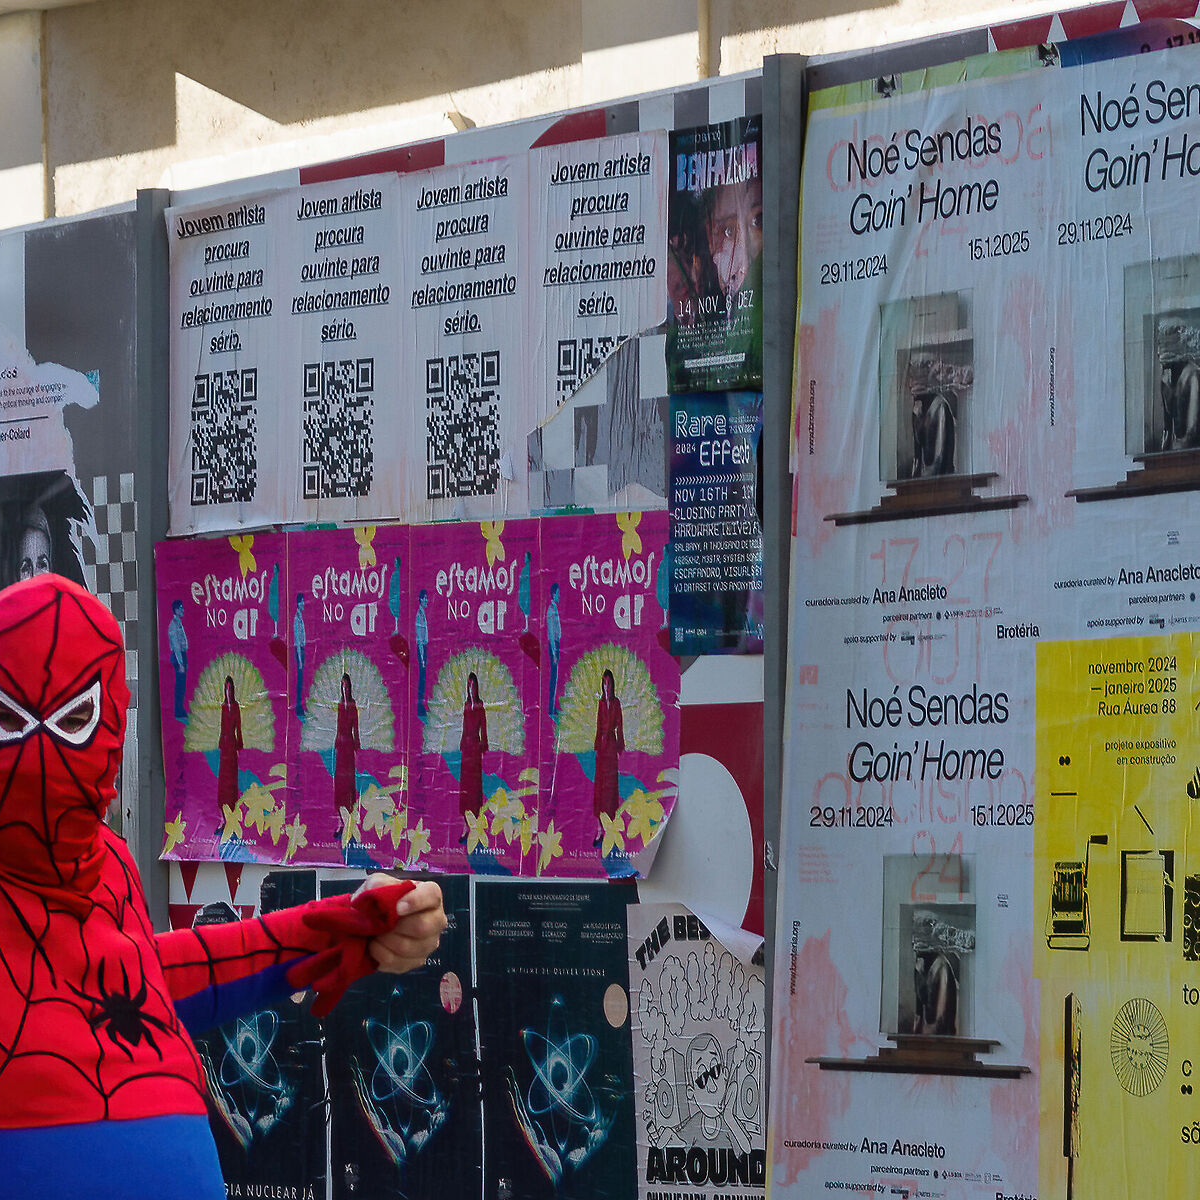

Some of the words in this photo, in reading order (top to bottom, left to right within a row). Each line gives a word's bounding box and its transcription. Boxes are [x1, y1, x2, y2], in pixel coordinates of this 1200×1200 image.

[1080, 82, 1140, 138] Noé
[847, 132, 900, 182] Noé
[904, 117, 1002, 171] Sendas
[551, 161, 599, 185] Jovem
[603, 152, 651, 177] artista
[297, 197, 338, 221] Jovem
[341, 189, 382, 214] artista
[417, 186, 460, 211] Jovem
[464, 176, 508, 201] artista
[571, 192, 629, 220] procura
[917, 179, 999, 223] Home
[177, 212, 224, 239] Jovem
[228, 204, 265, 227] artista
[435, 214, 489, 242] procura
[1057, 212, 1132, 245] 29.11.2024
[315, 225, 364, 252] procura
[554, 226, 609, 252] ouvinte
[612, 224, 645, 249] para
[968, 231, 1030, 261] 15.1.2025
[204, 240, 250, 265] procura
[421, 250, 470, 275] ouvinte
[474, 244, 506, 270] para
[301, 258, 347, 282] ouvinte
[350, 255, 380, 280] para
[543, 255, 656, 287] relacionamento
[821, 254, 888, 285] 29.11.2024
[190, 273, 233, 297] ouvinte
[236, 269, 264, 292] para
[411, 273, 517, 309] relacionamento
[181, 296, 273, 329] relacionamento
[291, 284, 390, 315] relacionamento
[577, 292, 618, 318] sério.
[738, 290, 754, 309] DEZ
[321, 319, 357, 342] sério.
[444, 310, 482, 336] sério.
[209, 330, 242, 354] sério.
[675, 410, 727, 438] Rare
[699, 437, 750, 467] Effect
[674, 489, 696, 503] NOV
[700, 487, 728, 501] 16TH
[674, 506, 716, 520] CLOSING
[719, 504, 748, 518] PARTY
[1118, 568, 1143, 585] Ana
[582, 594, 606, 614] NO
[873, 588, 896, 604] Ana
[898, 584, 947, 603] Anacleto
[206, 607, 227, 628] NO
[323, 600, 343, 623] NO
[447, 598, 470, 620] NO
[996, 623, 1039, 640] Brotéria
[1088, 660, 1144, 675] novembro
[1148, 656, 1177, 673] 2024
[1104, 680, 1145, 697] janeiro
[1148, 678, 1177, 694] 2025
[847, 683, 901, 729] Noé
[907, 683, 1009, 728] Sendas
[1098, 701, 1120, 717] Rua
[1123, 697, 1159, 716] Áurea
[1161, 699, 1176, 714] 88
[1105, 740, 1133, 753] projeto
[1135, 738, 1177, 751] expositivo
[920, 739, 1004, 781] Home
[1116, 755, 1128, 766] em
[1129, 753, 1176, 767] construção
[809, 805, 893, 828] 29.11.2024
[971, 803, 1034, 827] 15.1.2025
[635, 915, 671, 970] THE
[784, 1138, 821, 1150] curadoria
[849, 1142, 858, 1153] by
[860, 1137, 888, 1155] Ana
[891, 1138, 946, 1159] Anacleto
[646, 1146, 766, 1188] AROUND
[870, 1164, 903, 1175] parceiros
[903, 1166, 930, 1177] partners
[246, 1184, 297, 1200] NUCLEAR
[302, 1183, 315, 1200] JÁ
[824, 1180, 844, 1191] apoio
[845, 1182, 876, 1193] supported
[876, 1184, 886, 1195] by
